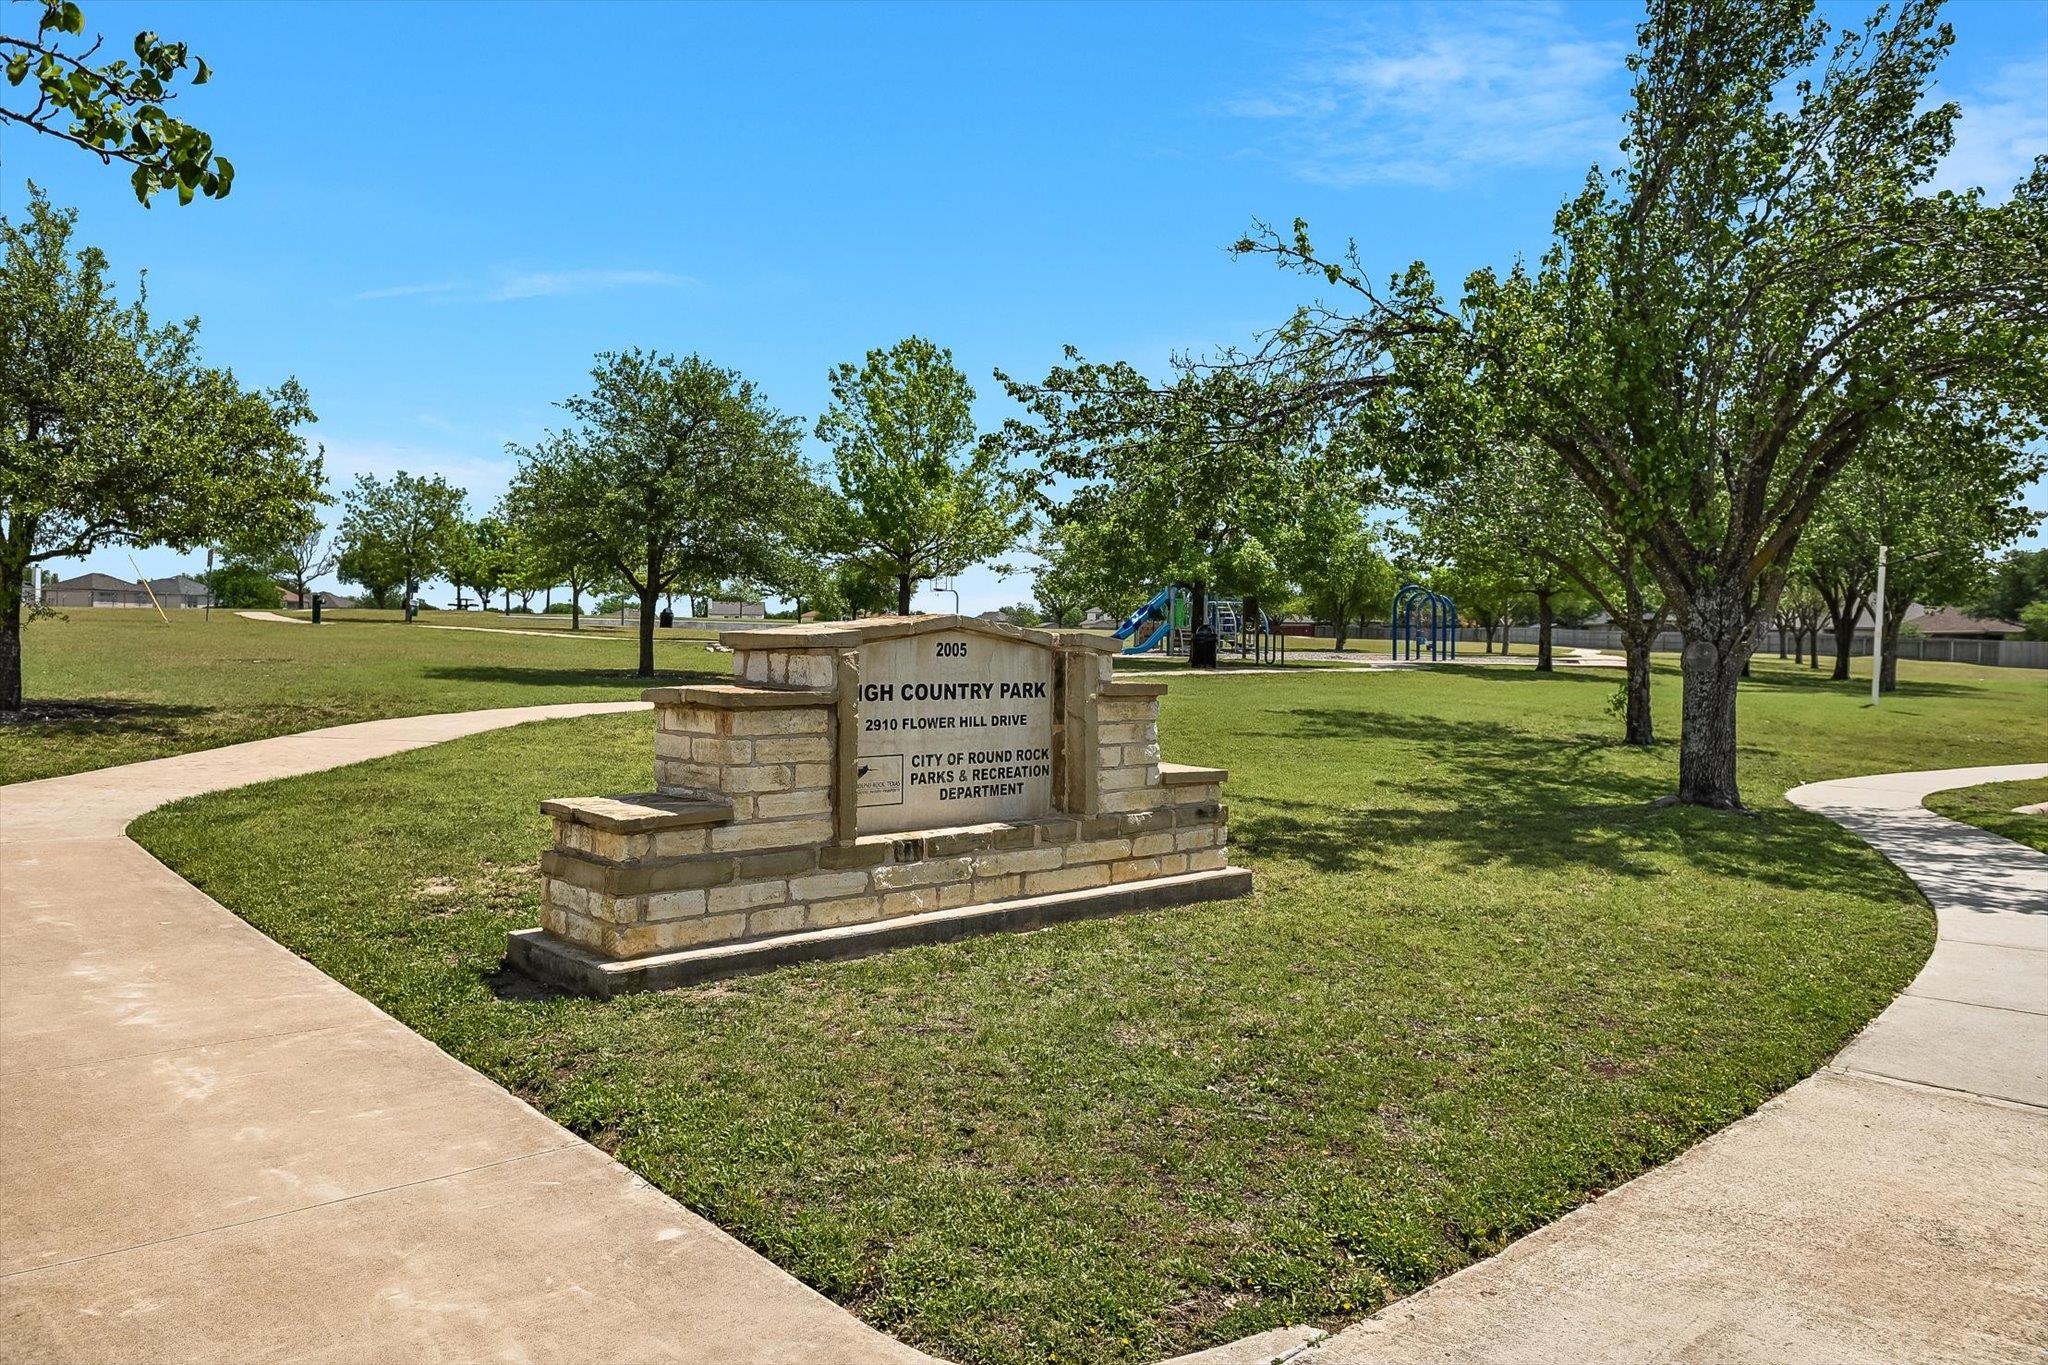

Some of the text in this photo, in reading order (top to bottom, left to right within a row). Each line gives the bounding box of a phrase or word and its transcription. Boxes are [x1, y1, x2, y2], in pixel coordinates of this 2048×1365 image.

[936, 642, 967, 657] 2005
[858, 682, 1047, 702] IGH COUNTRY PARK
[865, 714, 1027, 731] 2910 FLOWER HILL DRIVE
[911, 748, 1050, 768] CITY OF ROUND ROCK
[910, 764, 1050, 785] PARKS & RECREATION
[939, 782, 1024, 800] DEPARTMENT
